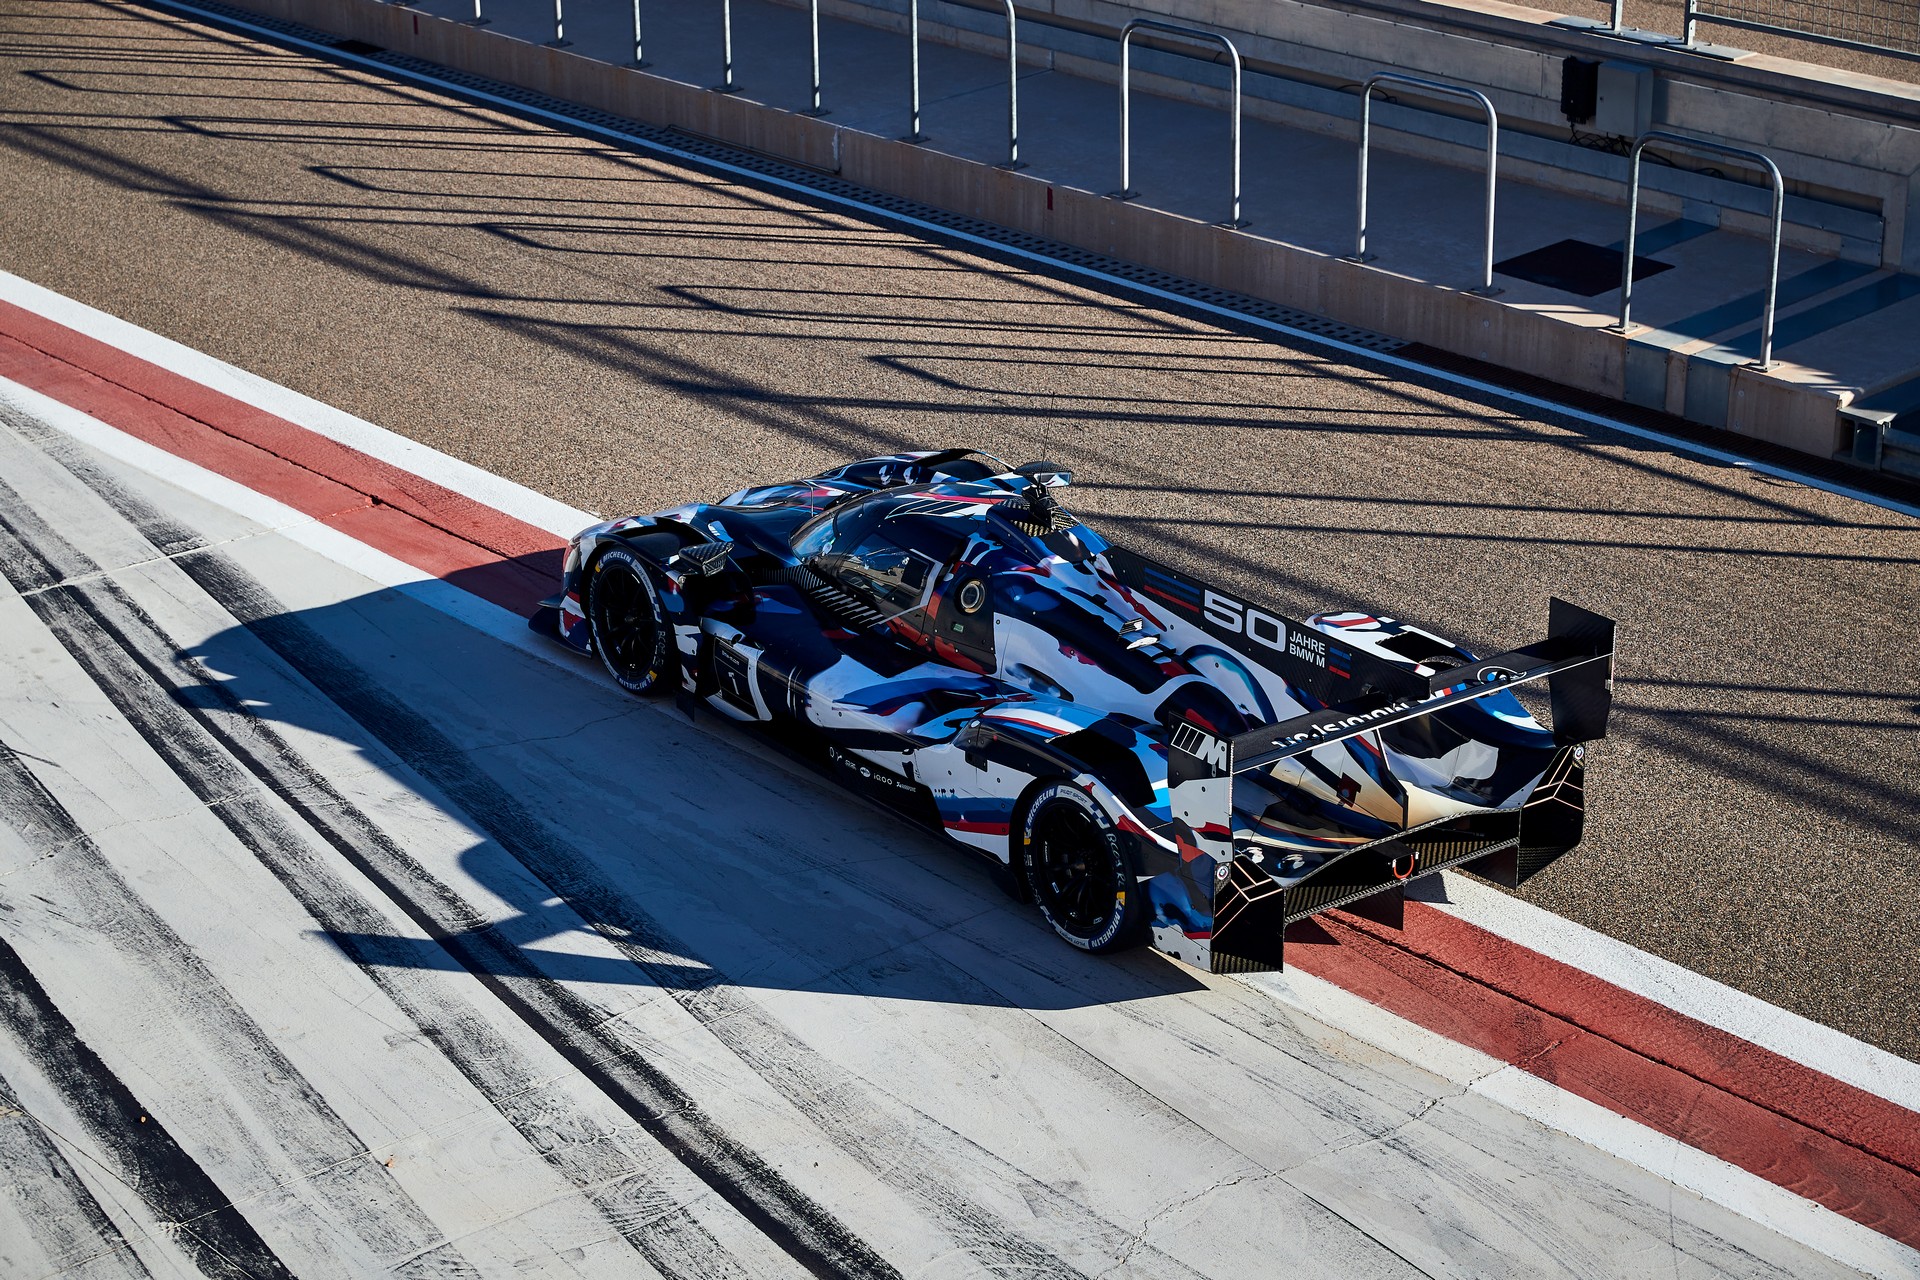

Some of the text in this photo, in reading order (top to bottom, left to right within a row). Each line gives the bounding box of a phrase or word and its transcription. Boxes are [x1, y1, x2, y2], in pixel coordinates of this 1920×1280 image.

[602, 551, 632, 563] MICHELIN
[1203, 589, 1287, 653] 50
[1289, 631, 1326, 656] JAHRE
[1289, 643, 1326, 669] BMW M
[1027, 787, 1056, 825] MICHELIN
[1091, 911, 1121, 948] MICHELIN
